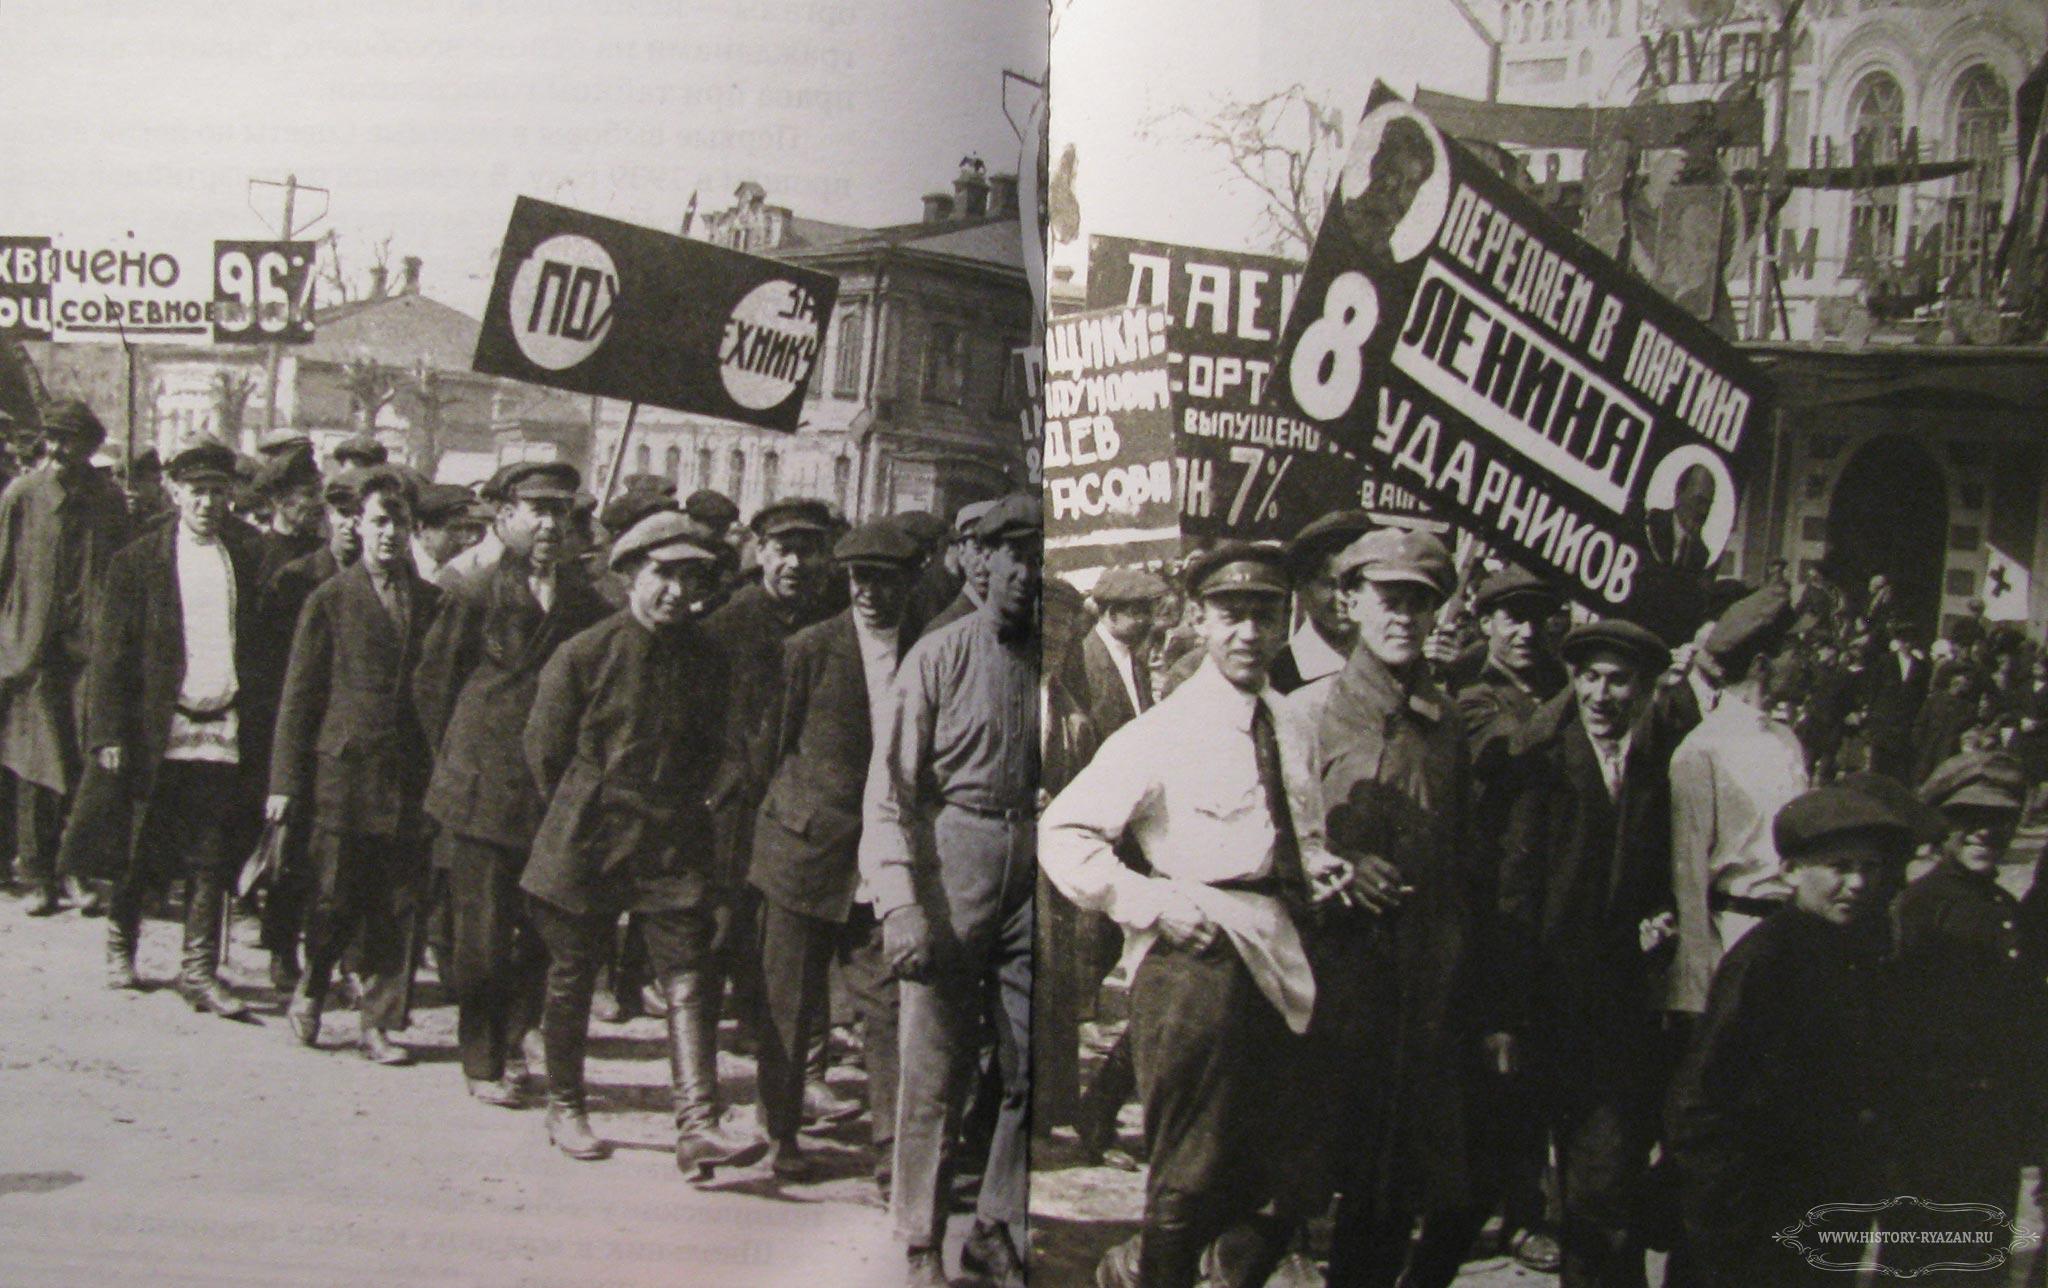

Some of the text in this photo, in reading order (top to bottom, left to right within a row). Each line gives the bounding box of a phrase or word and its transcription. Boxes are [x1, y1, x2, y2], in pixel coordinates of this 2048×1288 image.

[1290, 271, 1639, 604] 8 УДАРНИКОВ
[1588, 294, 1623, 363] В
[1622, 319, 1750, 452] ПАРТИЮ
[1227, 446, 1293, 526] 7%
